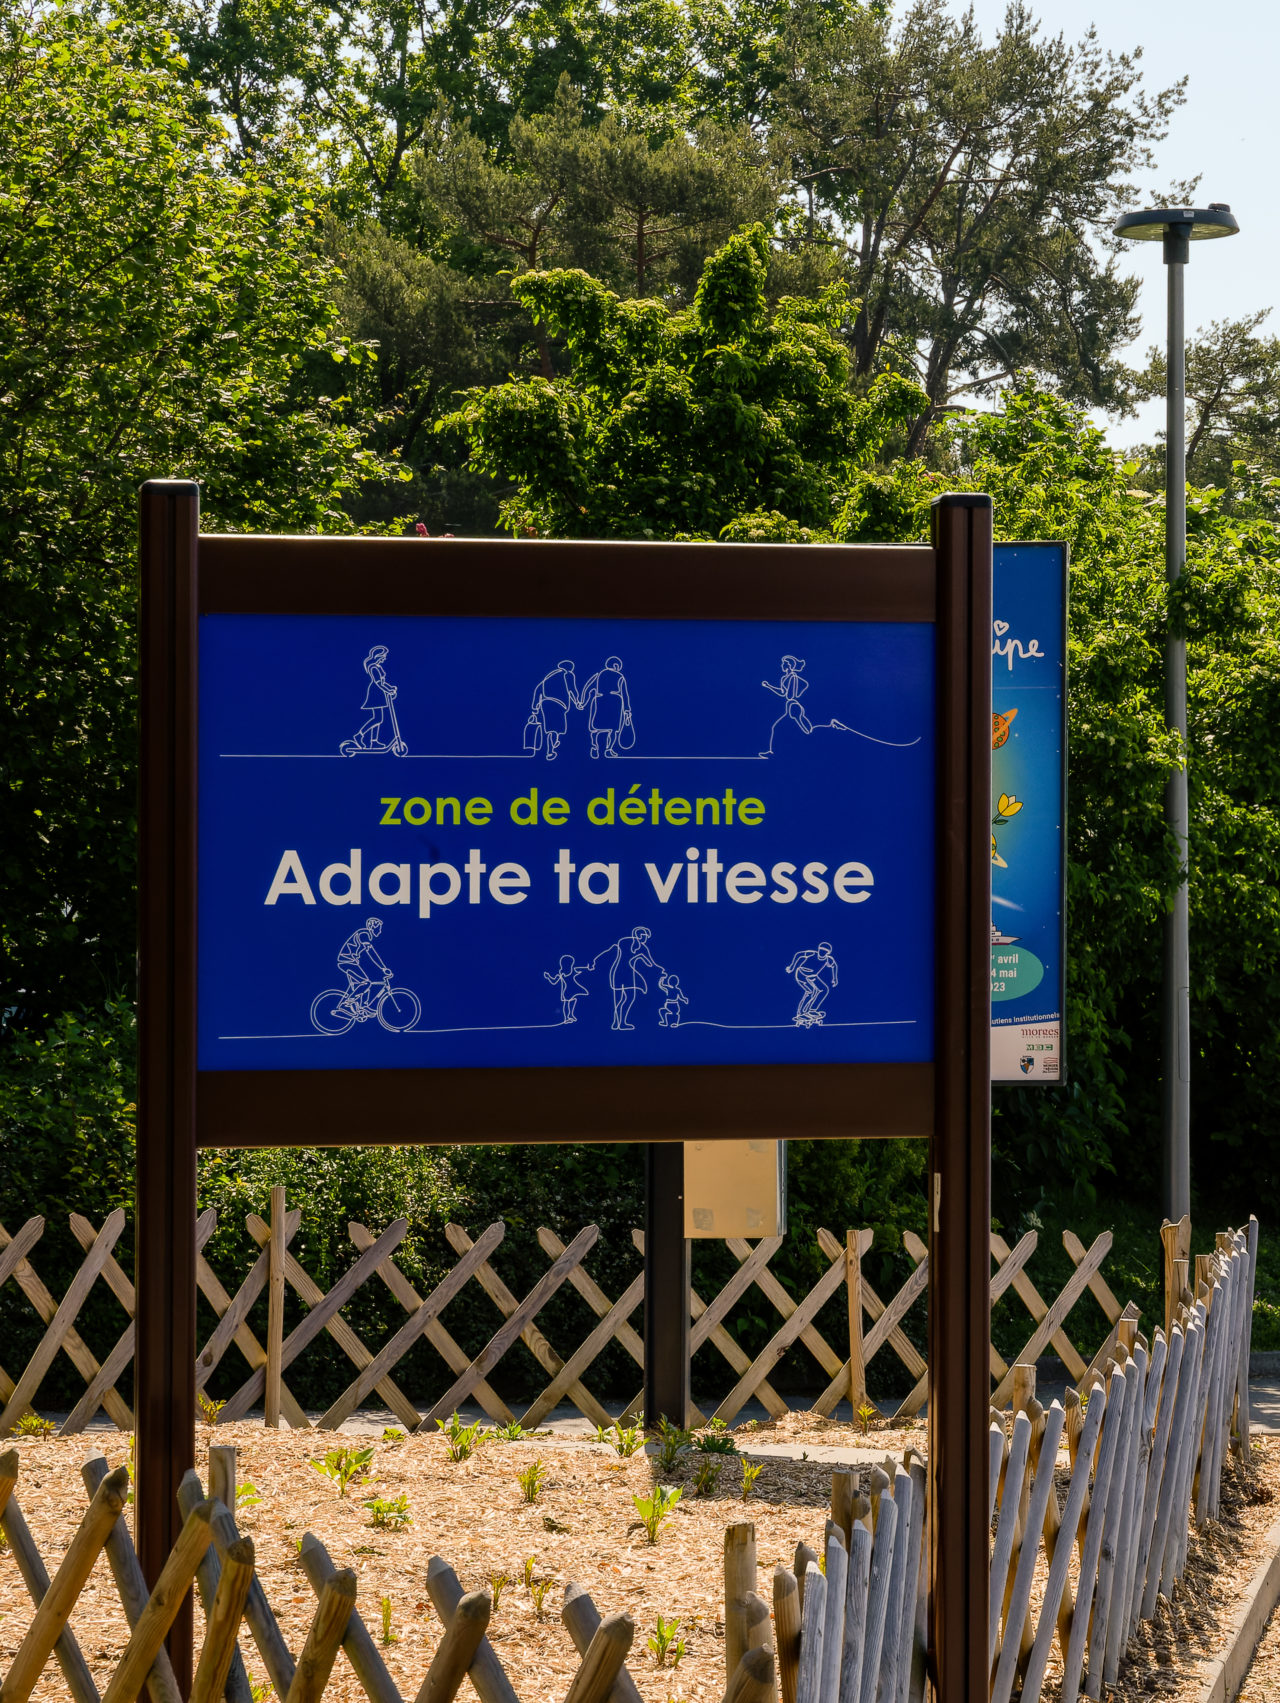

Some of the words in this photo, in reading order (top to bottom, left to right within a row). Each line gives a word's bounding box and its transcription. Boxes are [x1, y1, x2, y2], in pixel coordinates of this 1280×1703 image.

[993, 620, 1045, 671] ipe
[379, 796, 493, 826] zone
[509, 787, 571, 826] de
[586, 783, 766, 826] détente
[264, 848, 531, 919] Adapte
[554, 848, 620, 905] ta
[646, 847, 875, 904] vitesse
[998, 954, 1019, 964] avril
[1000, 968, 1017, 978] mai
